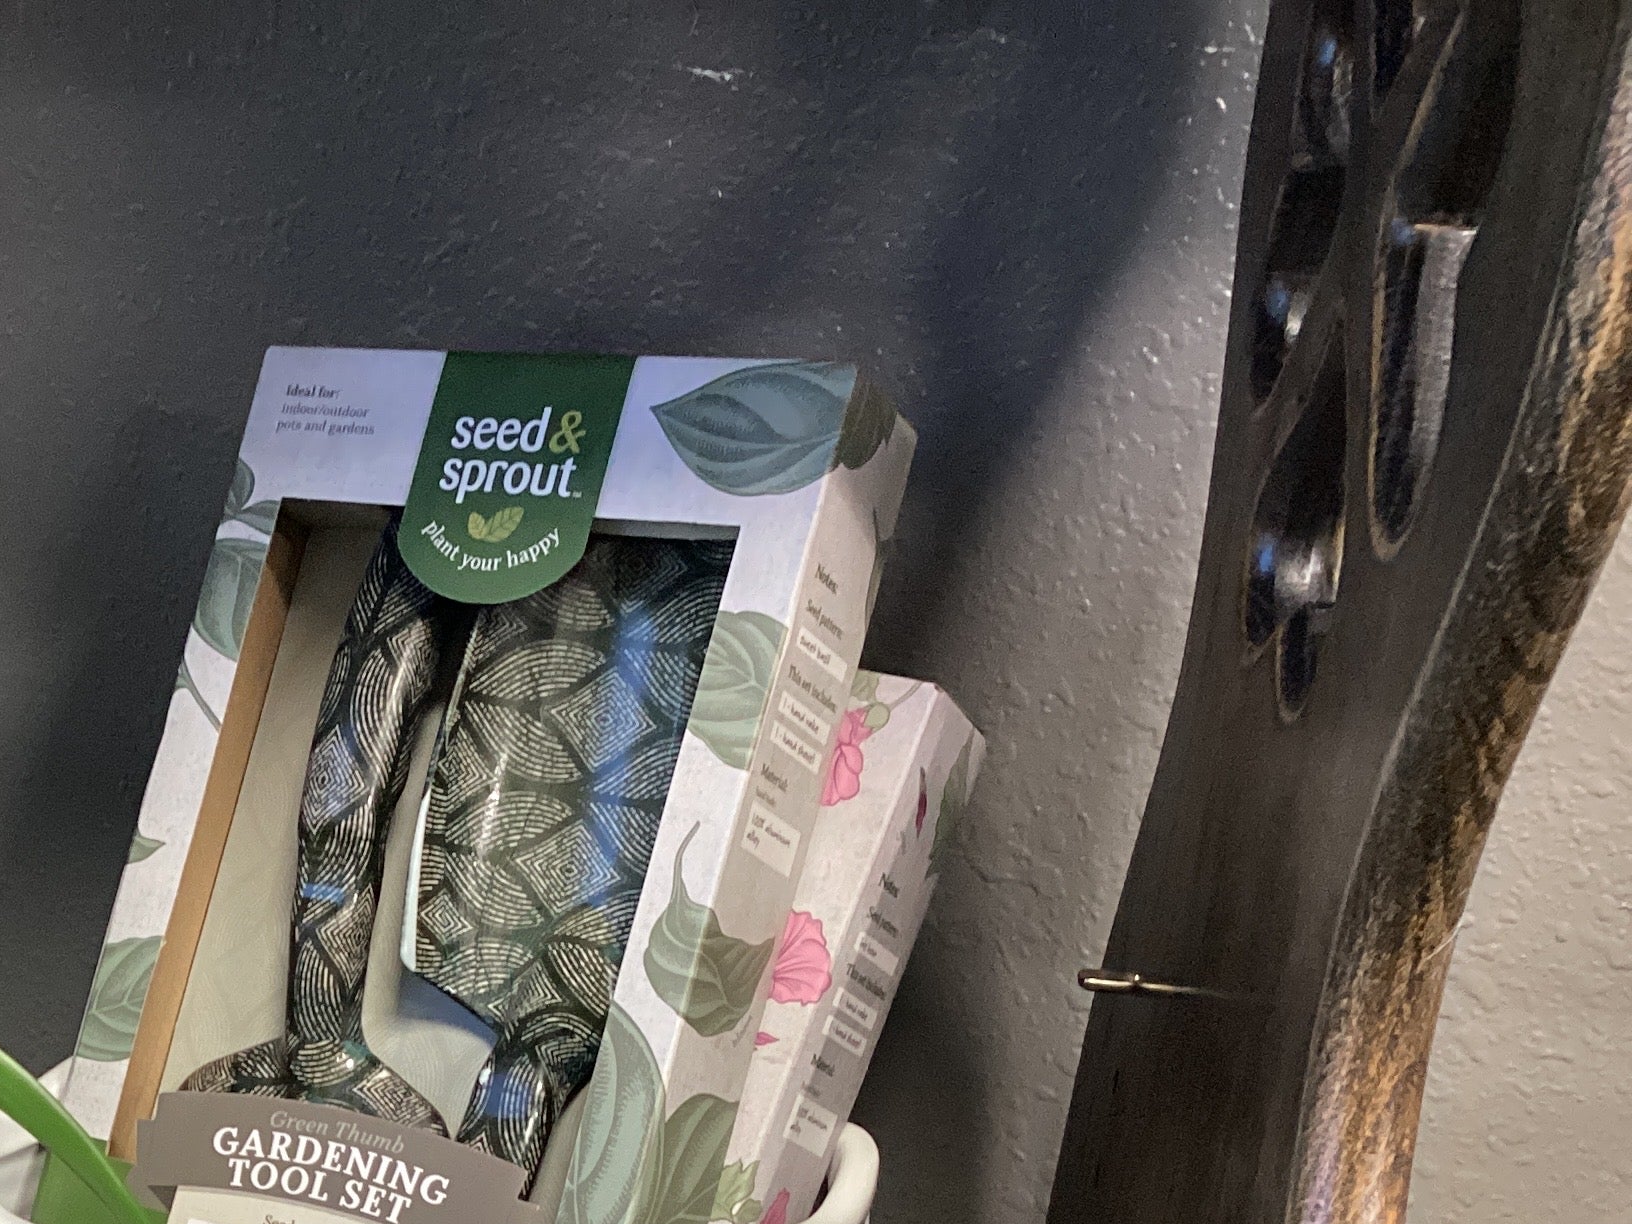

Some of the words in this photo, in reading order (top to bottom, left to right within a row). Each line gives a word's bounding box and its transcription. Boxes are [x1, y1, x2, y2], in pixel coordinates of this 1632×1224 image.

[286, 383, 316, 398] Ideal
[304, 419, 327, 433] and
[327, 421, 375, 437] gardens
[421, 520, 461, 561] plant
[458, 551, 502, 572] your
[506, 527, 561, 568] happy
[269, 1110, 329, 1138] Green
[335, 1120, 405, 1154] Thumb
[212, 1126, 450, 1207] GARDENING
[228, 1157, 328, 1203] TOOL
[339, 1180, 412, 1224] SET
